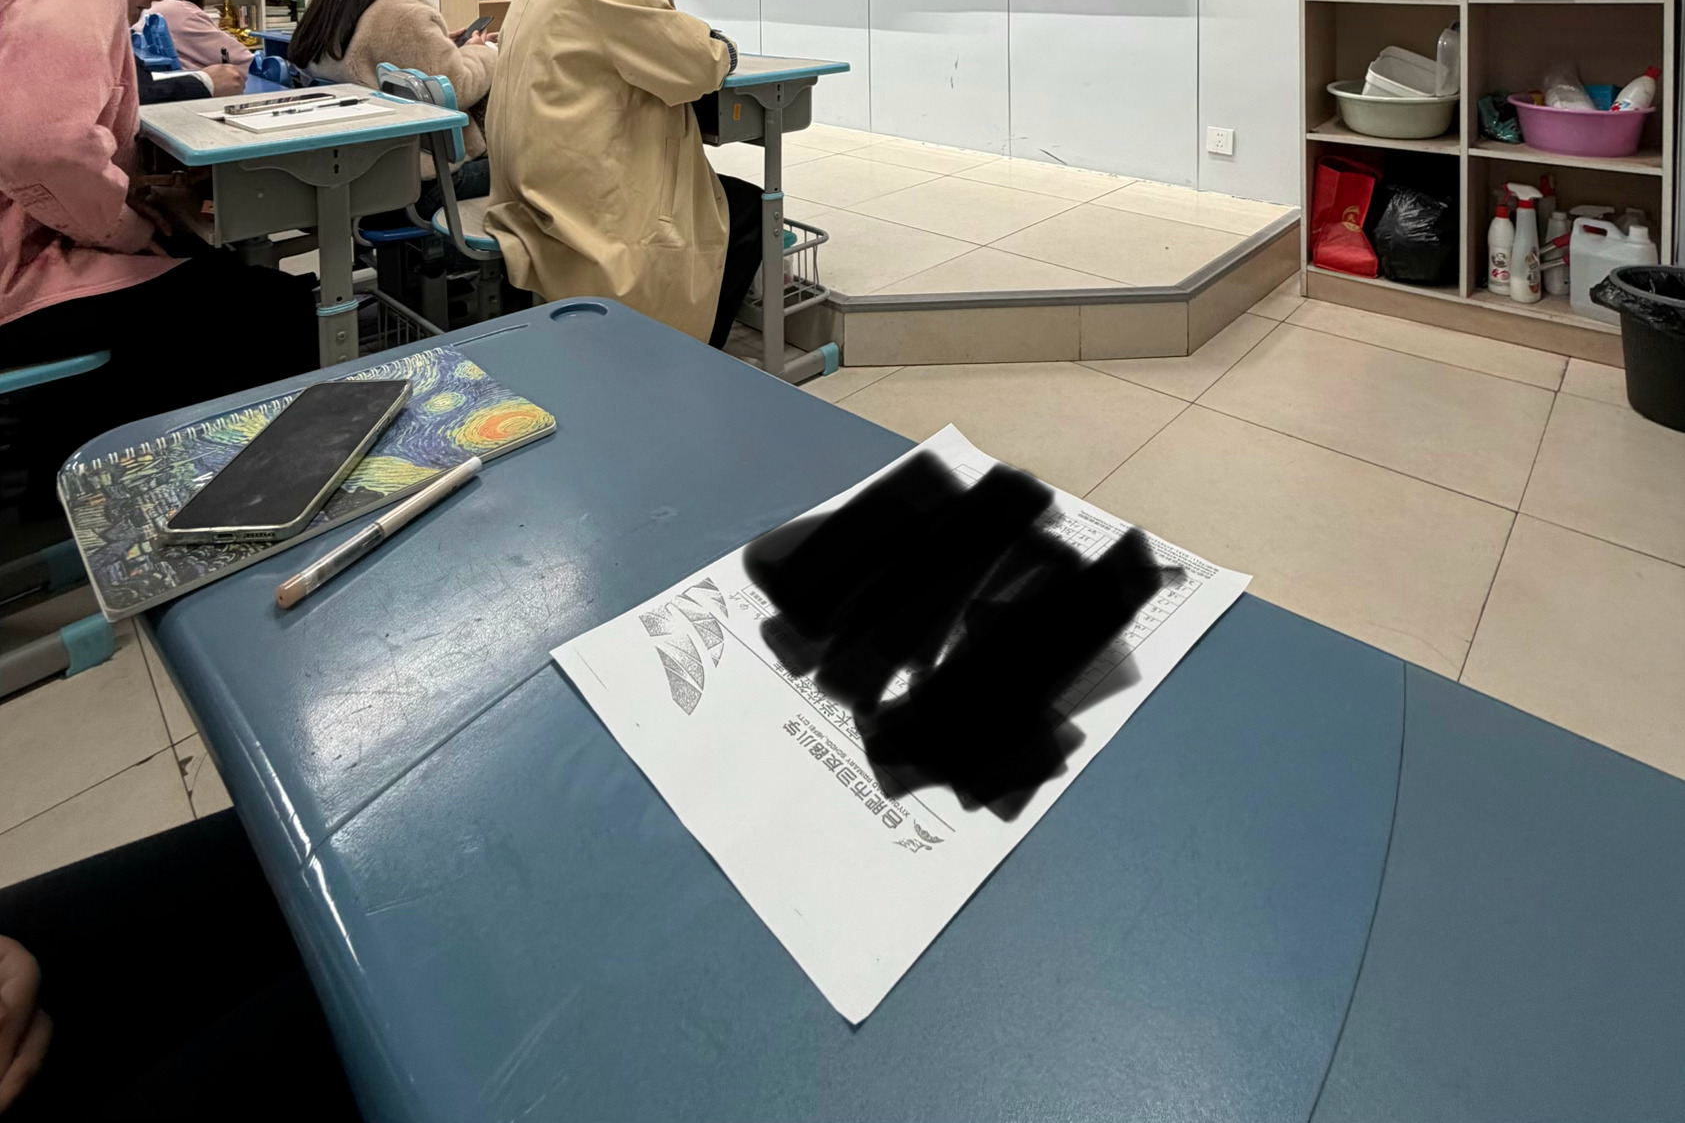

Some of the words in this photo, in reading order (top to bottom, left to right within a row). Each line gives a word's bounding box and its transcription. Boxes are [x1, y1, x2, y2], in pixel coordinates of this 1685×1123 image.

[783, 719, 903, 830] 合肥市习友路小学
[845, 757, 874, 785] PRIMARY
